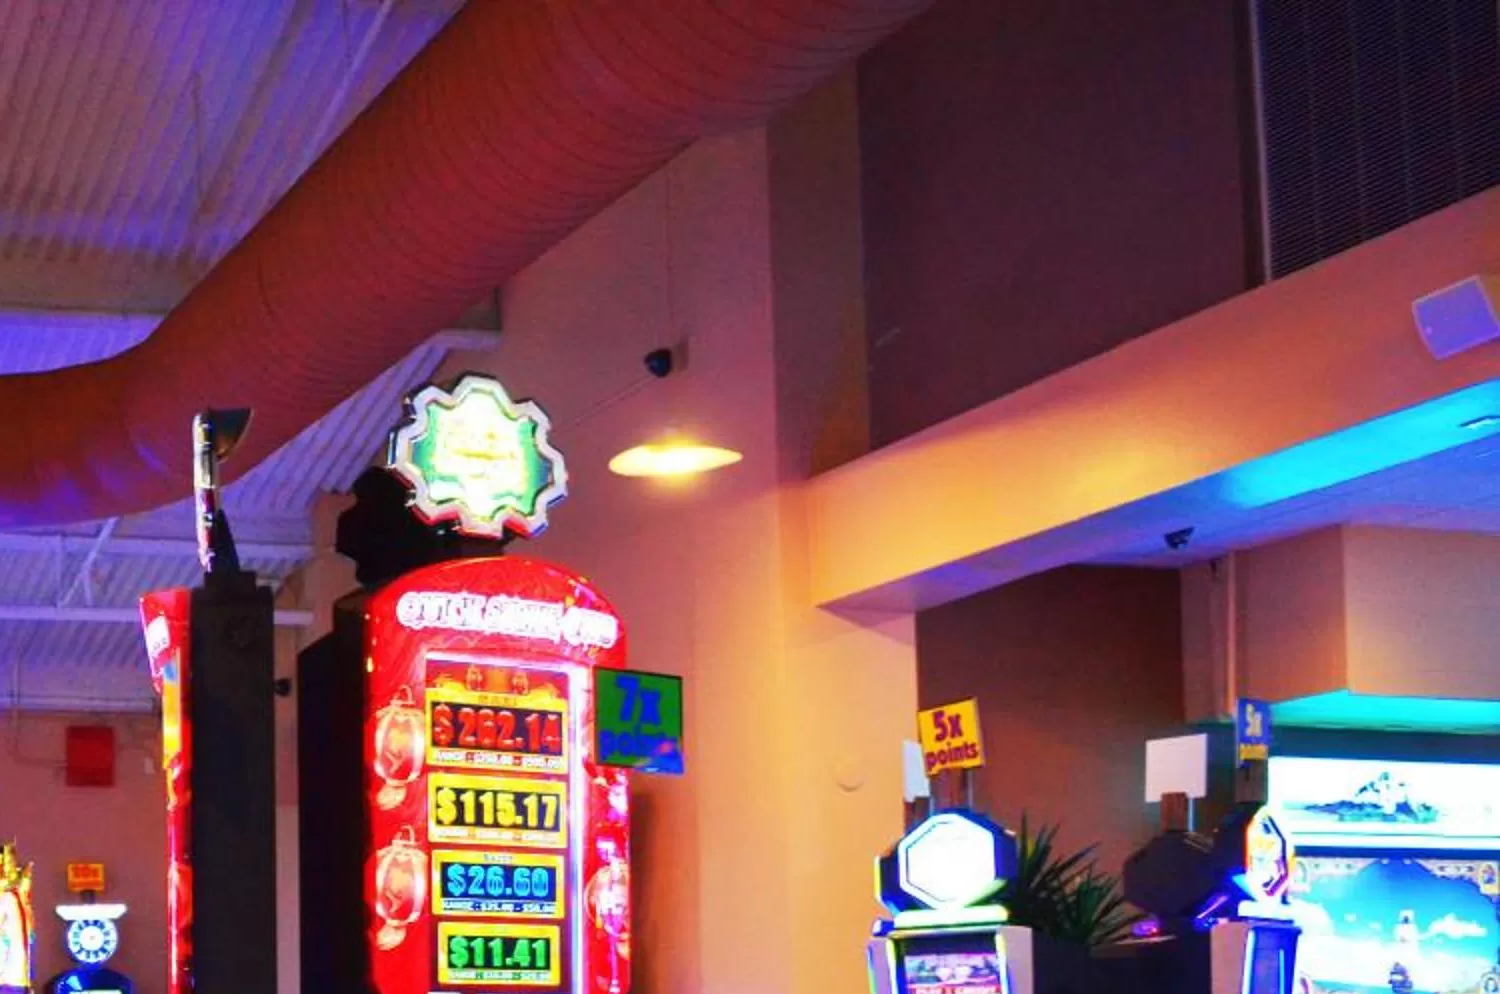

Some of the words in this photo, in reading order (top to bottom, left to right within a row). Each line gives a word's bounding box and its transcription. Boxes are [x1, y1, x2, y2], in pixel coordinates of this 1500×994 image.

[614, 674, 662, 726] 7x
[932, 709, 965, 743] 5x
[925, 741, 979, 773] points
[436, 787, 558, 829] $115.17
[446, 863, 550, 898] $26.60
[449, 935, 547, 970] $11.41
